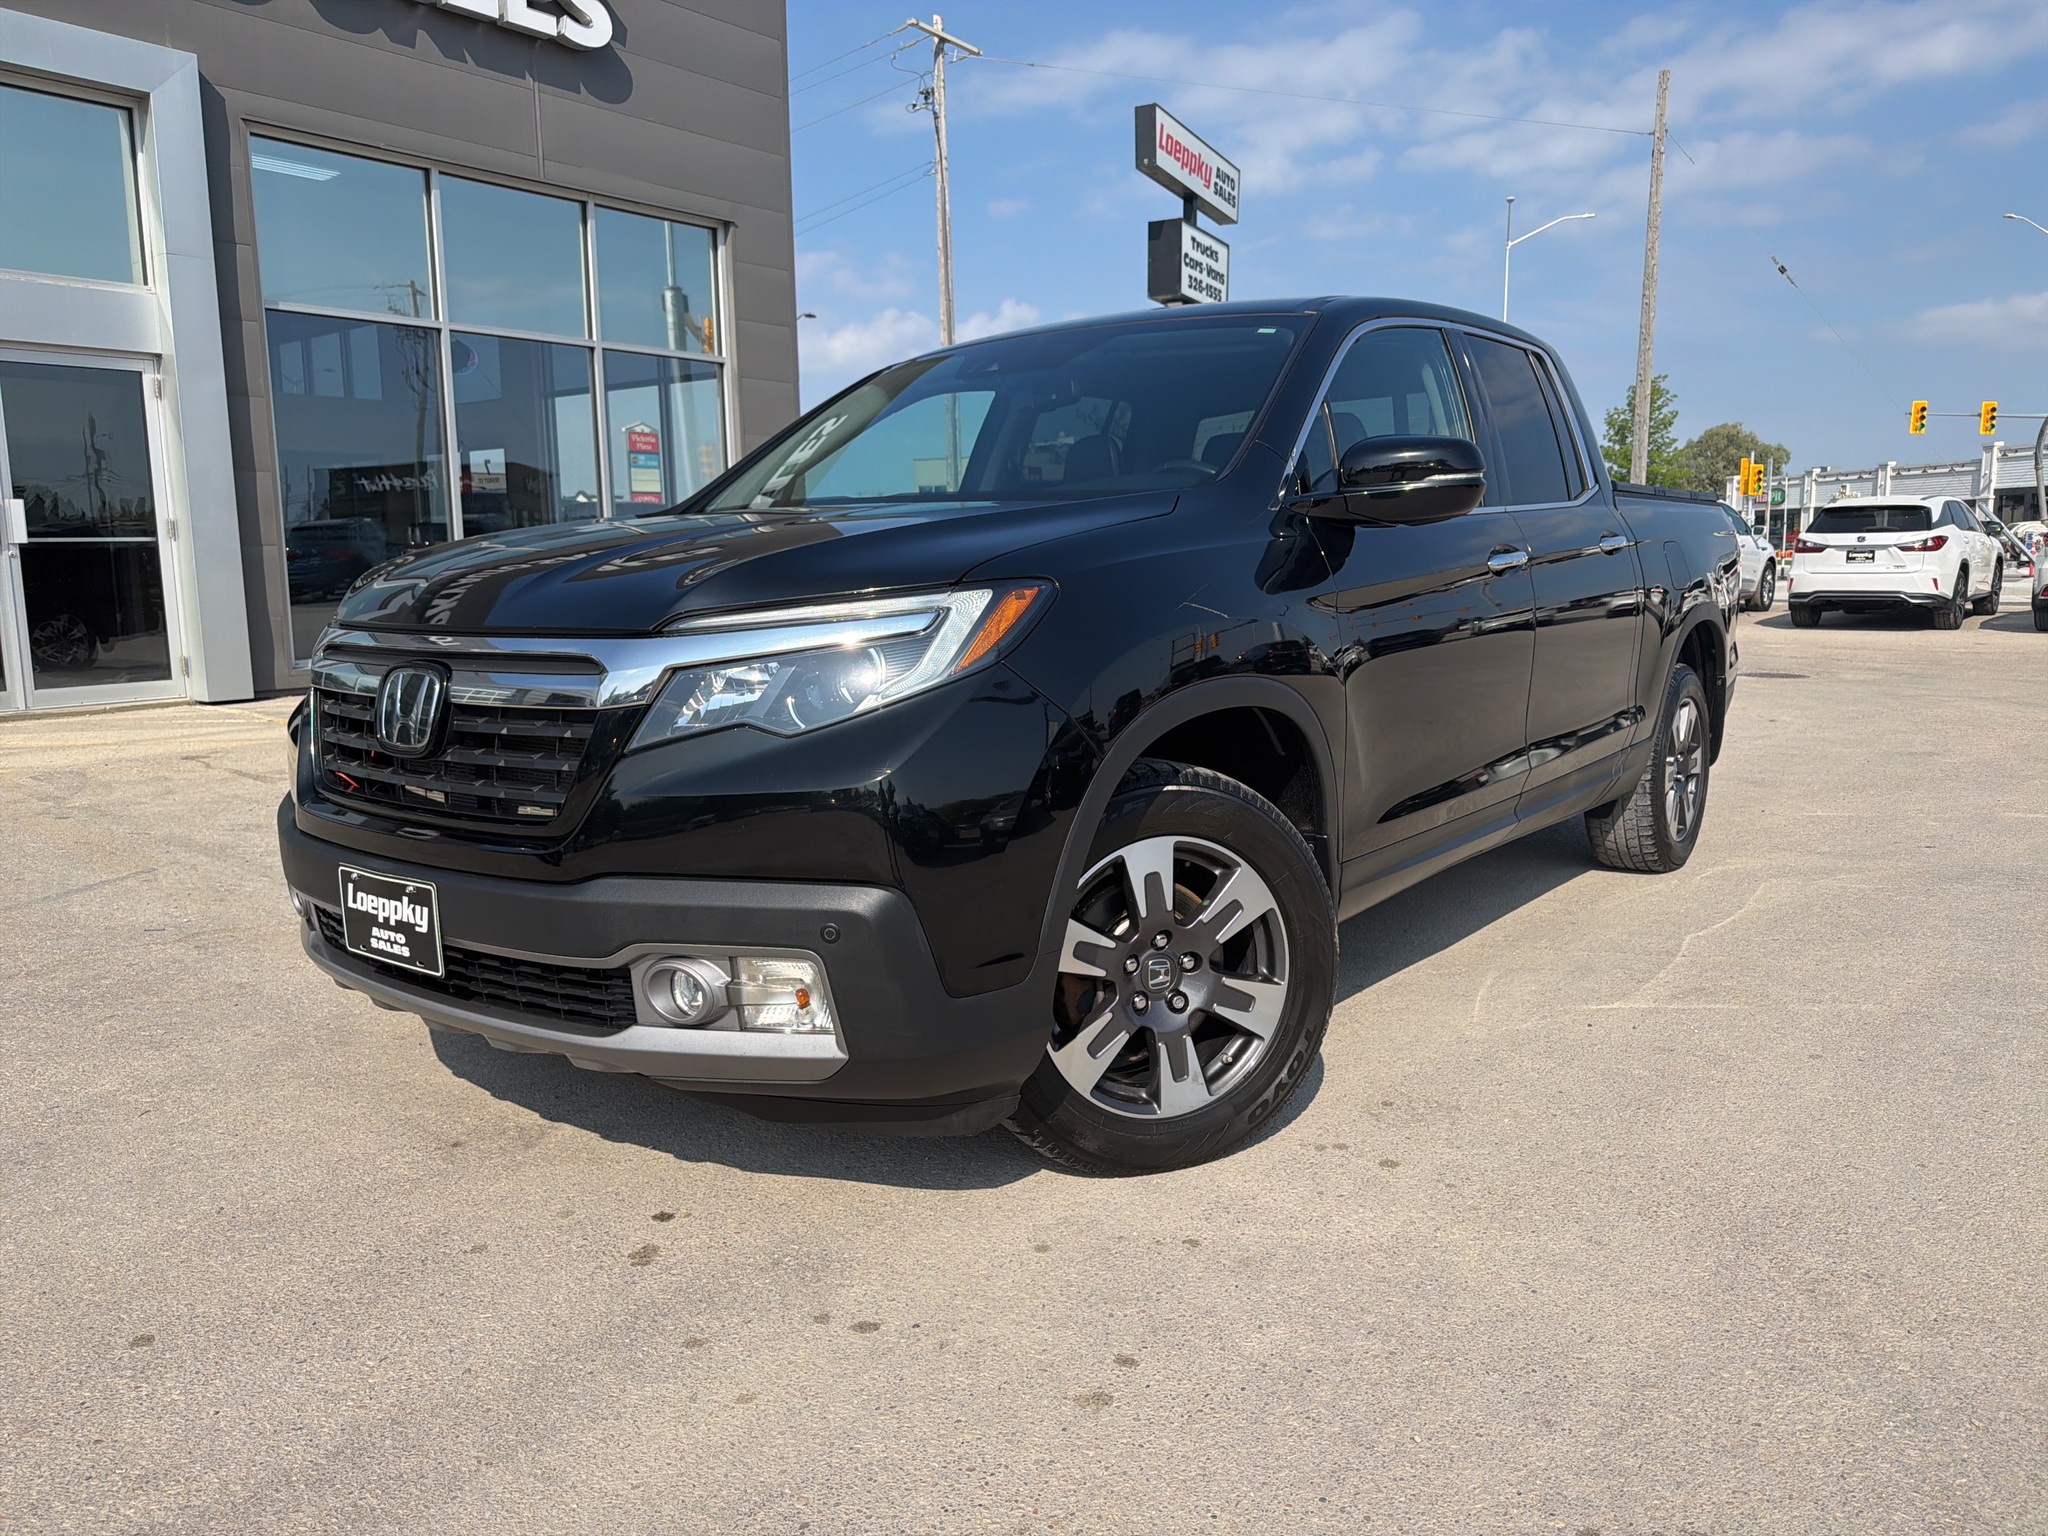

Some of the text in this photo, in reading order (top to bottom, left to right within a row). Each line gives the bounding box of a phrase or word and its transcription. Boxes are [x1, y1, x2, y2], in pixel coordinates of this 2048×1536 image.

[1158, 123, 1213, 190] Loeppky
[1215, 166, 1235, 191] AUTO
[1213, 181, 1236, 209] SALES
[1190, 235, 1219, 263] Trucks
[1187, 274, 1222, 302] 326-1555
[347, 882, 429, 934] Loeppky
[370, 937, 411, 957] SALES
[371, 926, 406, 944] AUTO
